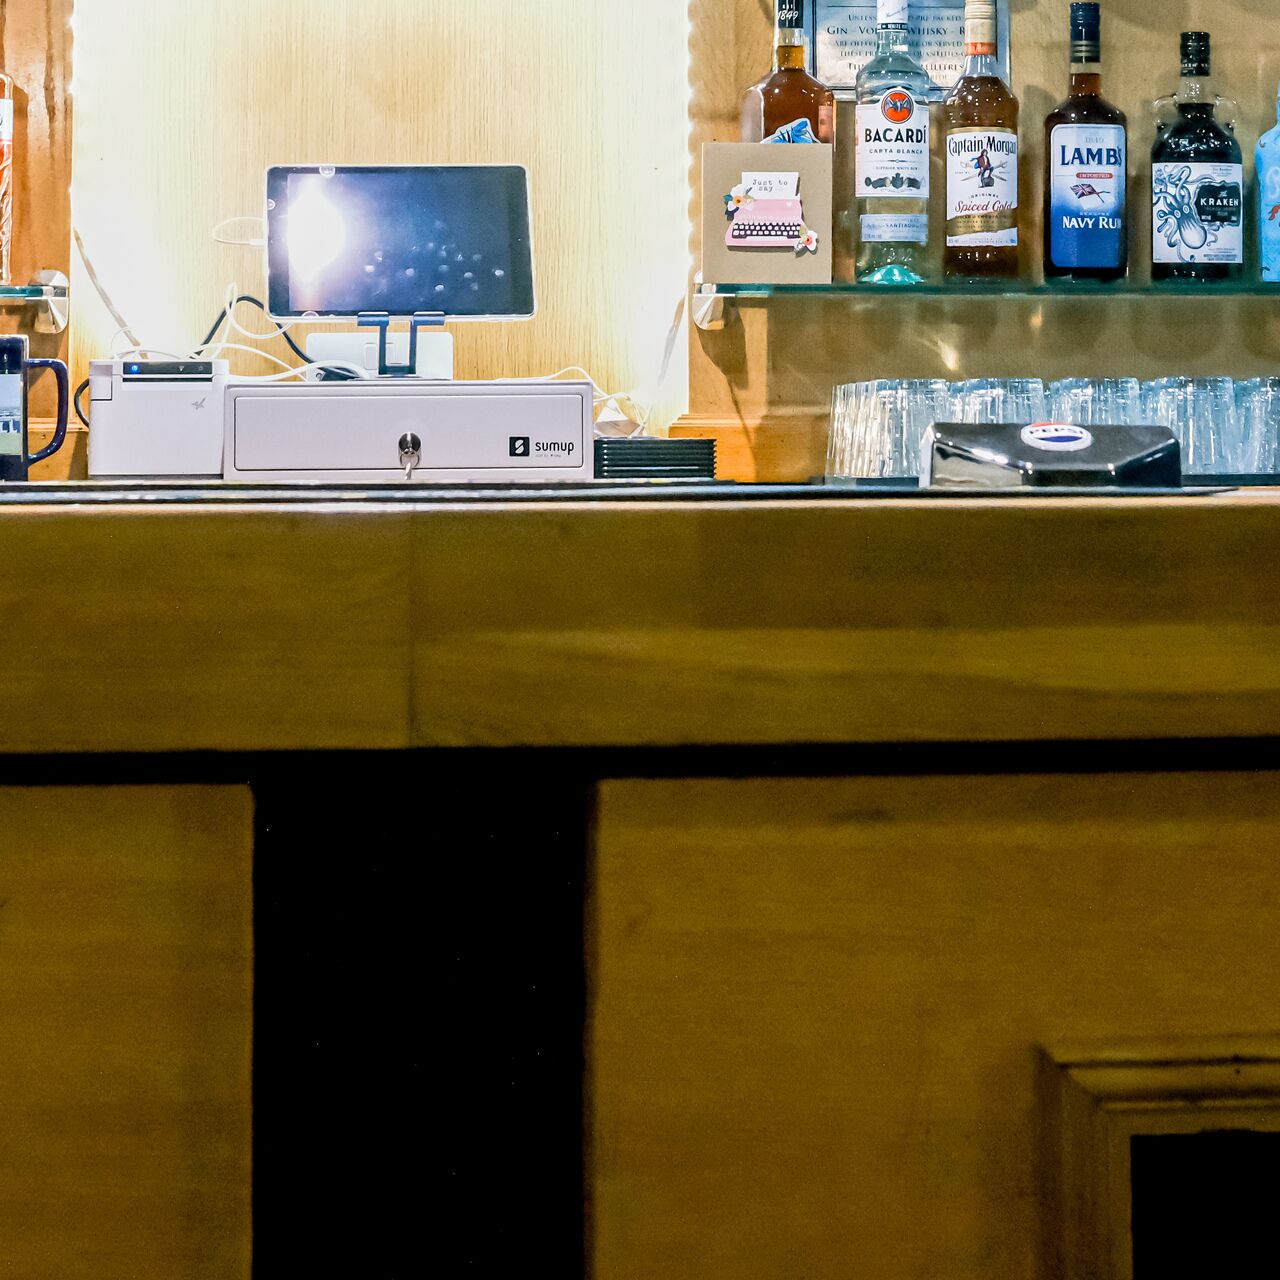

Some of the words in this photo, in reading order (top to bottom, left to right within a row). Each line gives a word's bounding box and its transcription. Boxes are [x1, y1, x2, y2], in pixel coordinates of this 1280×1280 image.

[777, 9, 798, 21] 1849
[827, 26, 848, 35] GIN
[865, 125, 926, 143] BACARDÍ
[949, 136, 983, 156] Captain
[955, 200, 990, 213] Spiced
[1200, 198, 1239, 206] KRAKEN
[1063, 216, 1095, 228] NAVY
[535, 442, 574, 455] sumup
